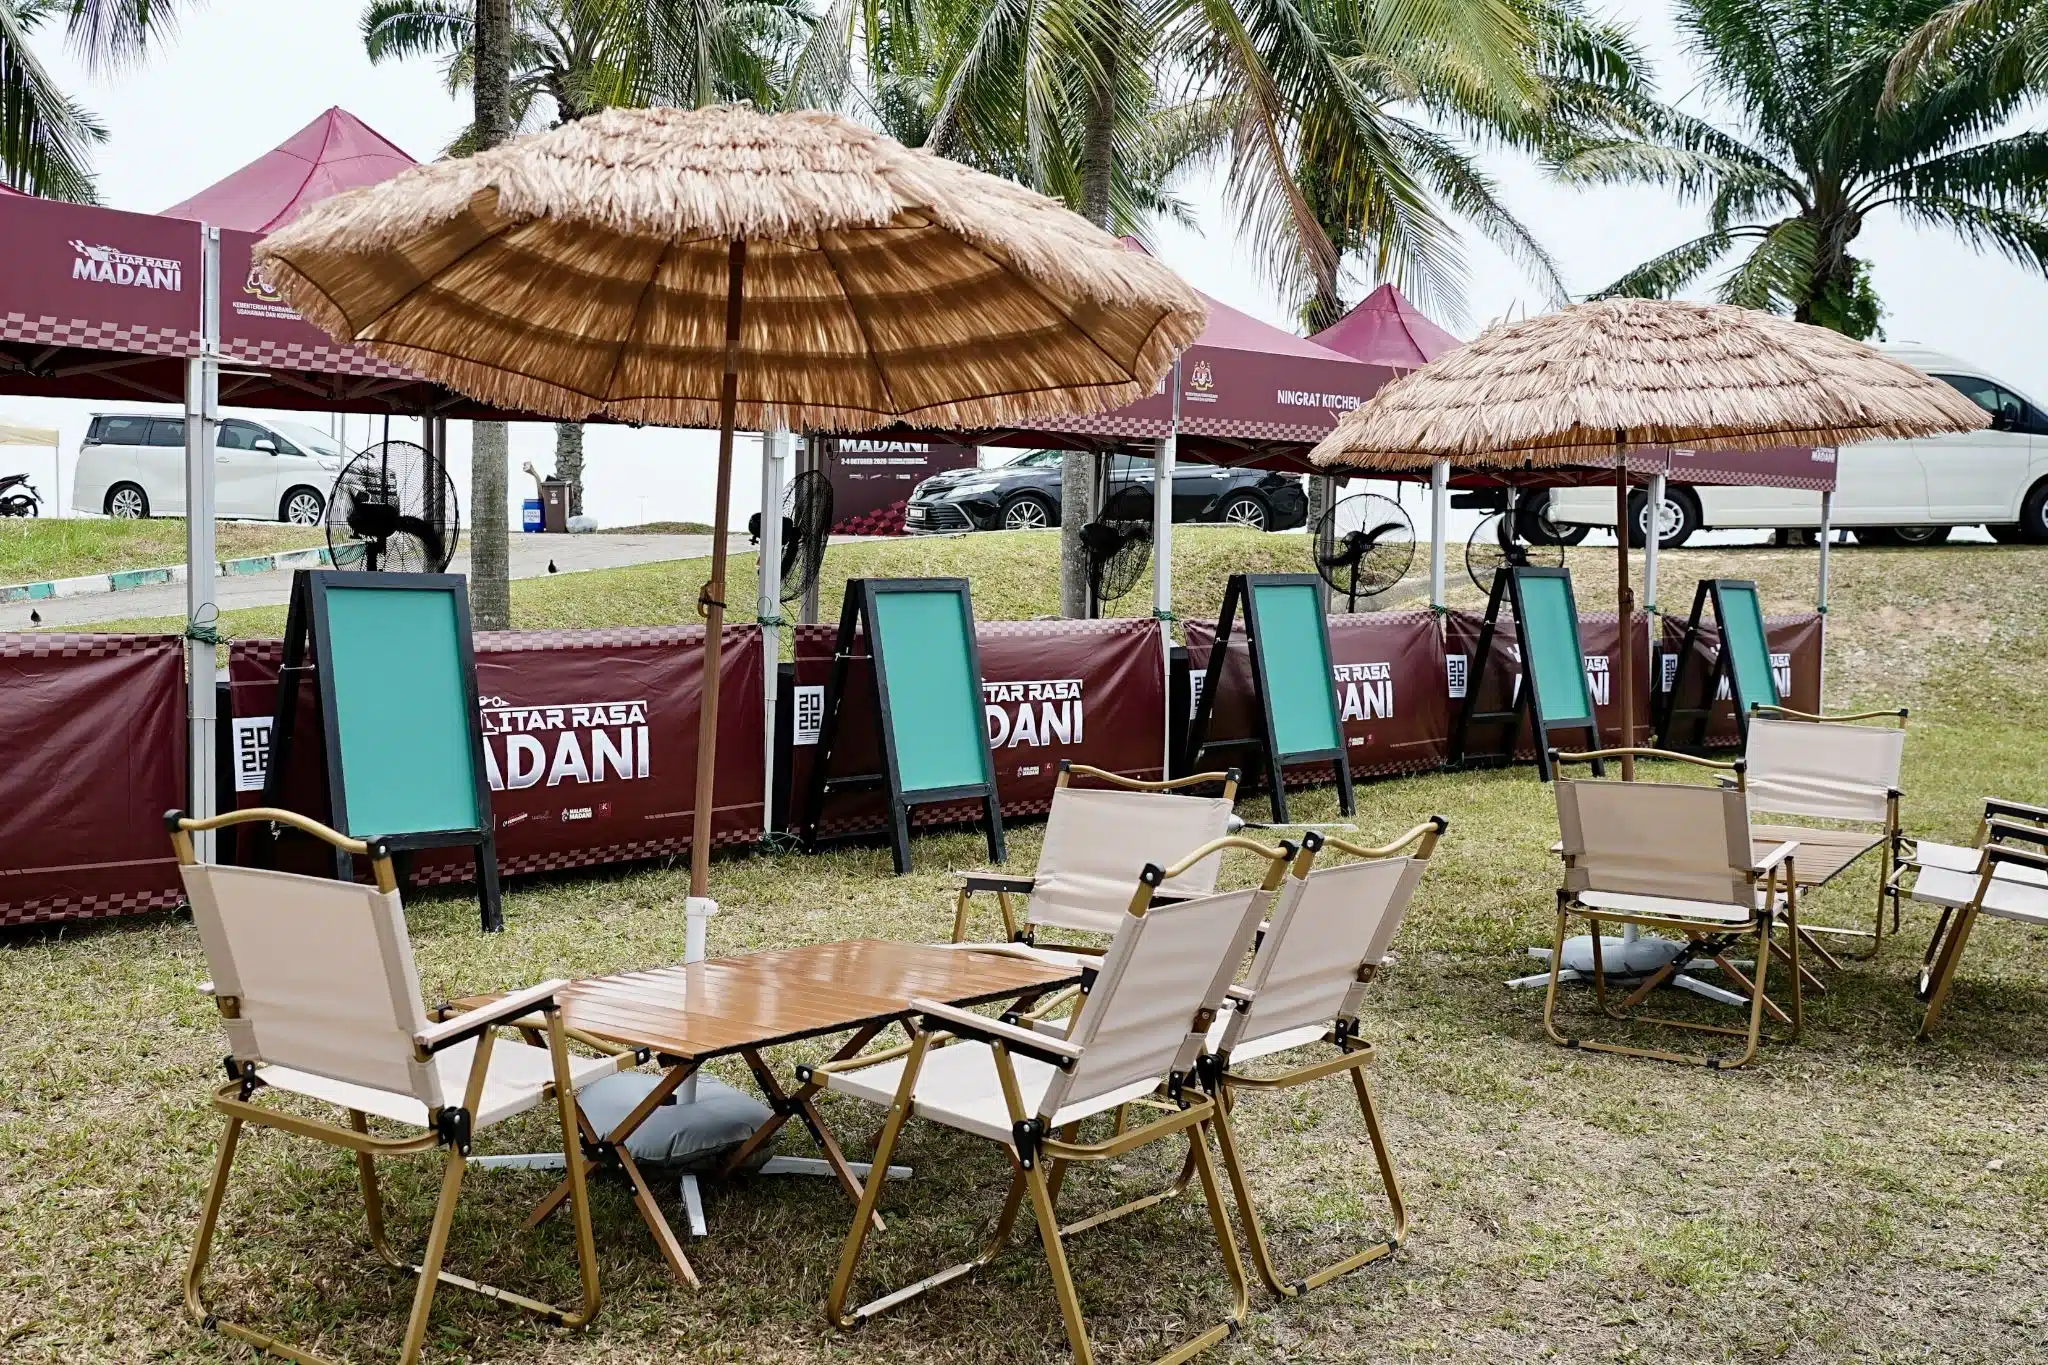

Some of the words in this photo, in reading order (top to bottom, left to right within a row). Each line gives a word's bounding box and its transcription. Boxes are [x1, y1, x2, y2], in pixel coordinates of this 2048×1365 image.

[146, 258, 180, 270] RASA
[72, 257, 181, 291] MADANI
[232, 302, 268, 311] KEMENTERIAN
[1277, 390, 1321, 407] NINGRAT
[1322, 394, 1361, 410] KITCHEN
[839, 438, 929, 452] MADANI
[1352, 665, 1390, 681] RASA
[1449, 661, 1465, 673] 20
[1450, 675, 1465, 686] 26
[983, 685, 1025, 702] TAR
[1028, 682, 1081, 700] RASA
[798, 694, 820, 710] 20
[1337, 680, 1393, 721] ANI
[571, 704, 647, 728] RASA
[799, 713, 820, 729] 26
[985, 700, 1084, 749] DANI
[240, 727, 271, 748] 20
[482, 725, 649, 791] DANI
[569, 811, 593, 820] MADANI
